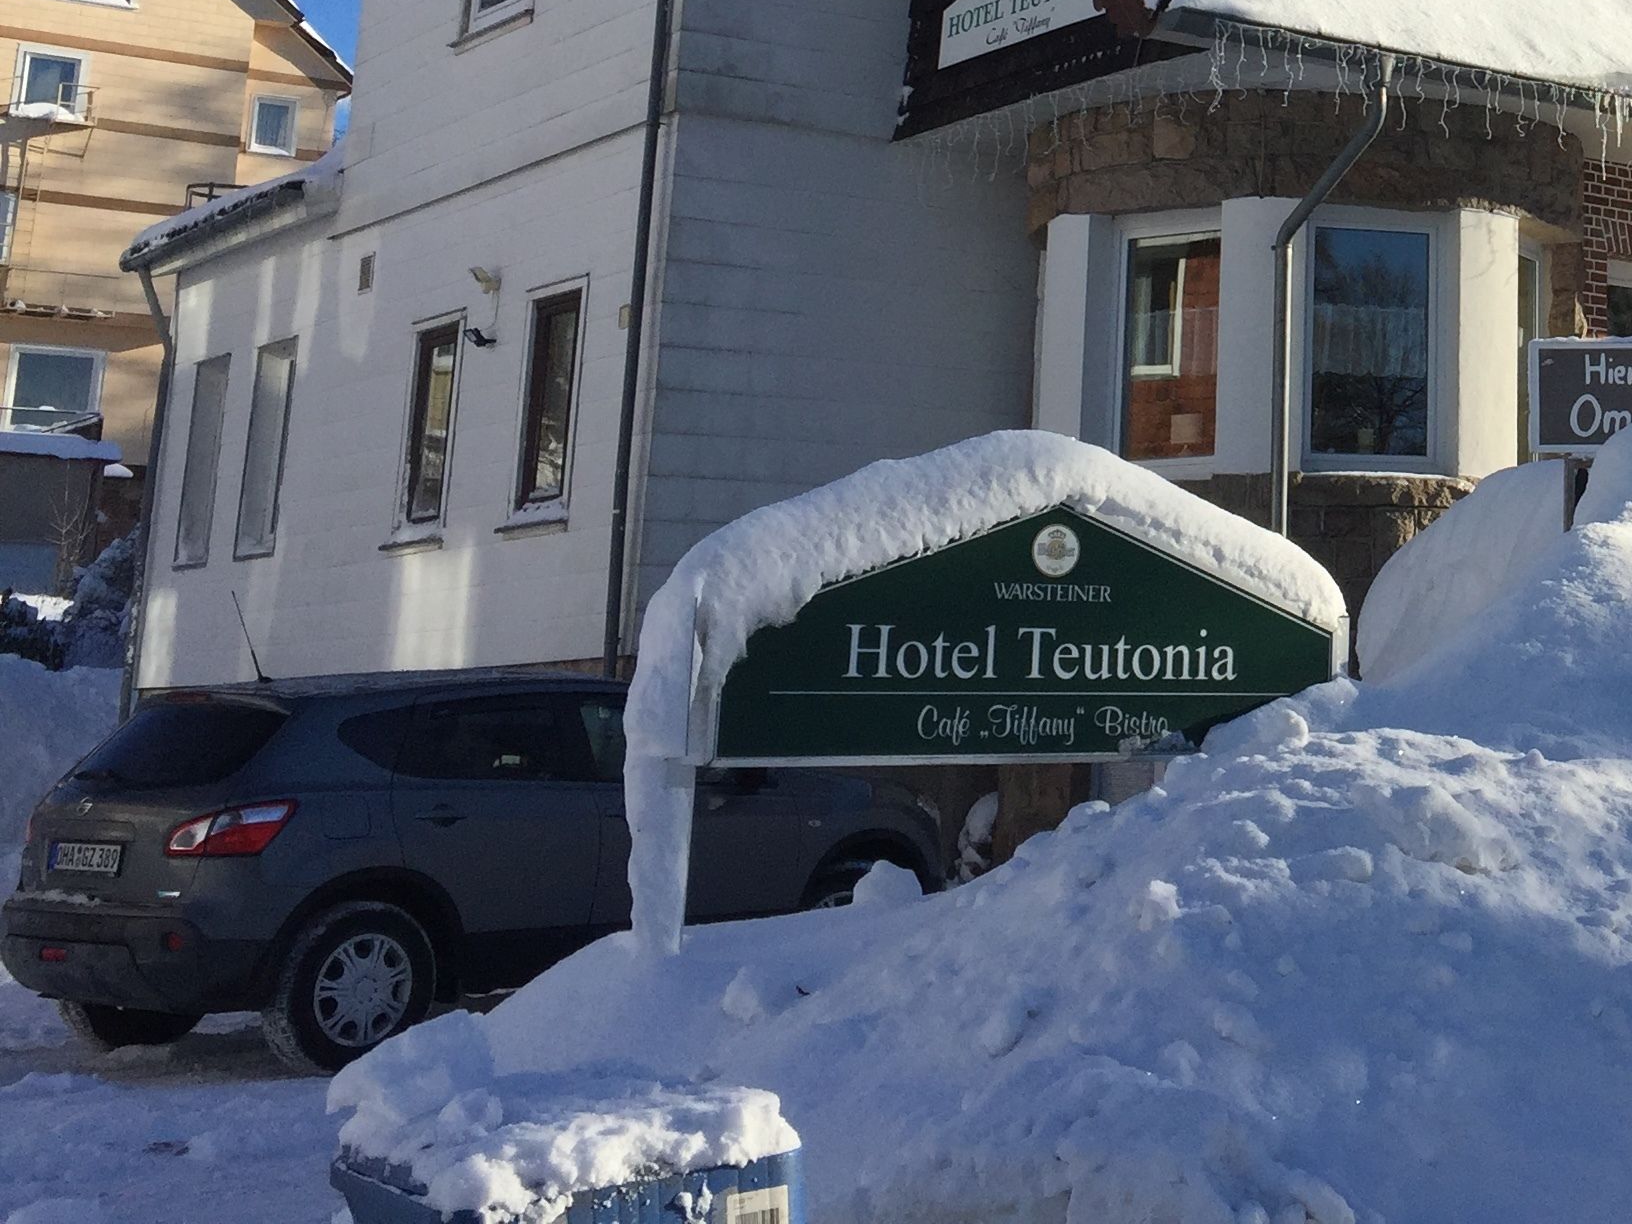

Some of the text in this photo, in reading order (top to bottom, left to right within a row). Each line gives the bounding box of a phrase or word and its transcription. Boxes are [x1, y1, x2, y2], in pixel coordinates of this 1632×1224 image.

[947, 0, 1005, 38] HOTEL
[993, 582, 1112, 602] WARSTEINER
[841, 623, 1238, 681] Hotel Teutonia
[917, 704, 970, 746] Café
[1095, 705, 1170, 737] Bistro
[96, 847, 119, 870] 389
